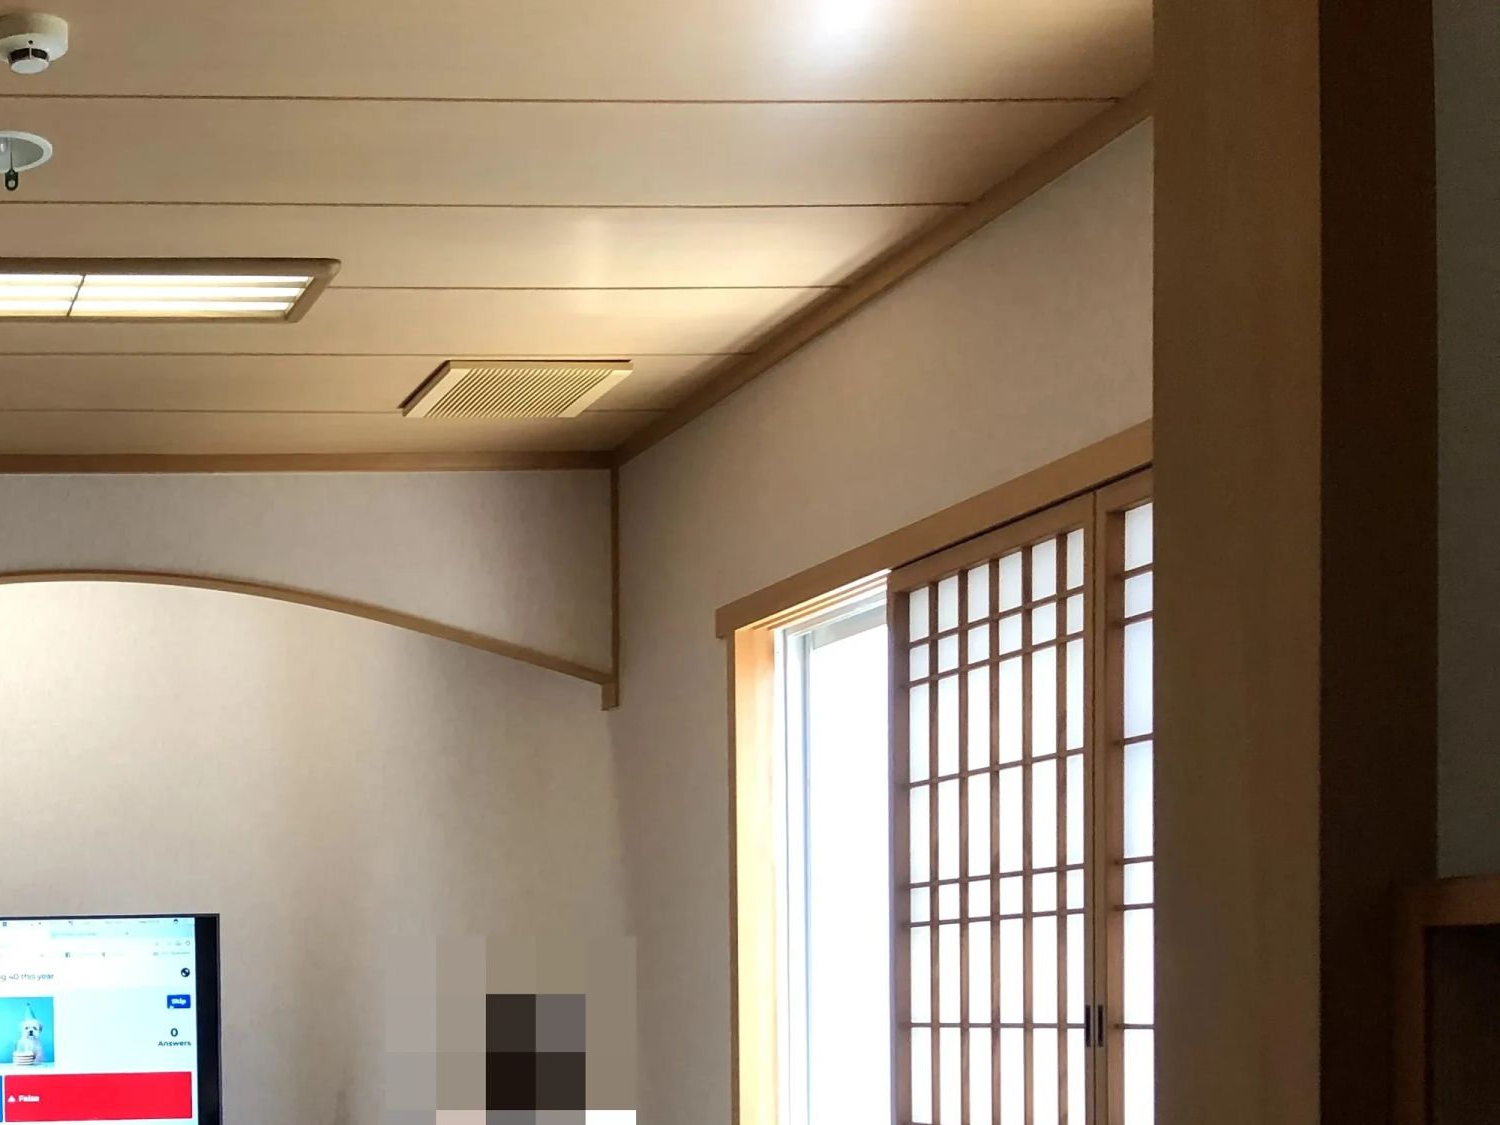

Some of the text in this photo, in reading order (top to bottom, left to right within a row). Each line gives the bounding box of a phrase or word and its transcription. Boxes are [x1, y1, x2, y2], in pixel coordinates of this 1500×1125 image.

[20, 972, 35, 980] this
[37, 973, 54, 981] year
[18, 1095, 40, 1103] False
